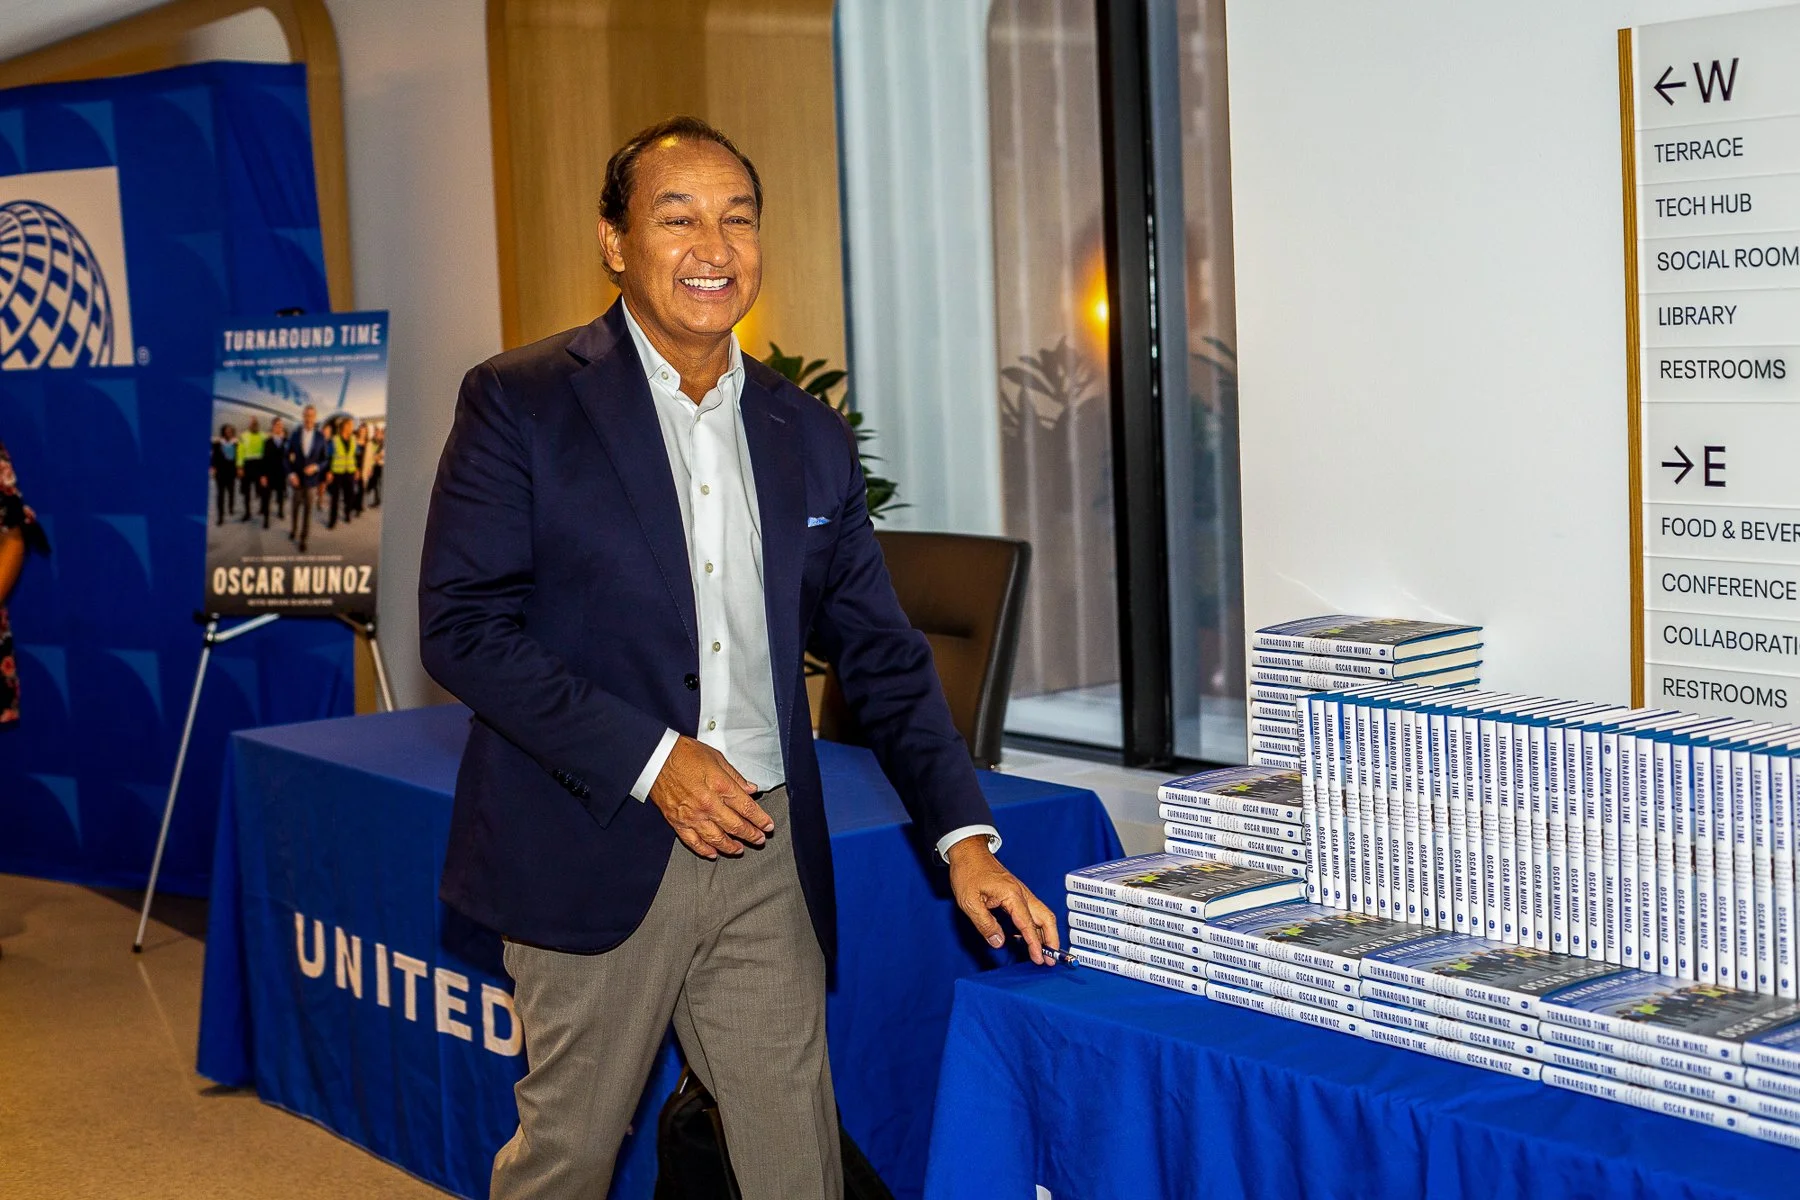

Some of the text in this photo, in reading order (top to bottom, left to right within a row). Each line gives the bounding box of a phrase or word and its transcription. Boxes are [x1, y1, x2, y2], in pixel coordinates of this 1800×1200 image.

[1693, 58, 1739, 103] W
[1654, 137, 1744, 163] TERRACE
[1656, 193, 1752, 217] TECH HUB
[1657, 250, 1730, 270] SOCIAL
[1658, 305, 1737, 326] LIBRARY
[224, 324, 381, 351] TURNAROUND TIME
[1660, 359, 1786, 379] RESTROOMS
[1704, 446, 1726, 487] E
[1662, 517, 1716, 538] FOOD
[1722, 520, 1736, 539] &
[213, 565, 372, 595] OSCAR MUNOZ
[1662, 573, 1797, 600] CONFERENCE
[1260, 637, 1291, 647] TURNAROUND
[1292, 640, 1304, 648] TIME
[1336, 645, 1352, 653] OSCAR
[1353, 646, 1371, 655] MUNOZ
[1663, 625, 1800, 656] COLLABORATI
[1259, 656, 1290, 665] TURNAROUND
[1291, 659, 1303, 667] TIME
[1335, 663, 1351, 672] OSCAR
[1353, 665, 1370, 674] MUNOZ
[1663, 678, 1788, 708] RESTROOMS
[1372, 720, 1380, 768] TURNAROUND
[1403, 723, 1411, 772] TURNAROUND
[1431, 728, 1440, 777] TURNAROUND
[1431, 728, 1440, 777] TURNAROUND
[1449, 729, 1458, 779] TURNAROUND
[1464, 731, 1473, 781] TURNAROUND
[1483, 733, 1491, 783] TURNAROUND
[1515, 738, 1523, 789] TURNAROUND
[1549, 742, 1557, 793] TURNAROUND
[1451, 782, 1459, 798] TIME
[1585, 746, 1594, 818] TURNAROUND TIME
[1639, 753, 1647, 806] TURNAROUND
[1165, 791, 1197, 803] TURNAROUND
[1198, 796, 1210, 805] TIME
[1484, 787, 1492, 804] TIME
[1696, 762, 1705, 836] TURNAROUND TIME
[1167, 809, 1198, 821] TURNAROUND
[1200, 815, 1211, 824] TIME
[1242, 804, 1258, 813] OSCAR
[1260, 806, 1278, 816] MUNOZ
[1604, 797, 1612, 823] OSCAR
[1172, 826, 1202, 839] TURNAROUND
[1204, 832, 1216, 842] TIME
[1244, 822, 1260, 832] OSCAR
[1261, 825, 1279, 835] MUNOZ
[1172, 845, 1216, 860] TURNAROUND TIME
[1247, 840, 1264, 850] OSCAR
[1265, 844, 1283, 854] MUNOZ
[1391, 839, 1399, 862] OSCAR
[1247, 859, 1264, 869] OSCAR
[1266, 863, 1284, 873] MUNOZ
[1436, 846, 1444, 870] OSCAR
[1436, 846, 1444, 870] OSCAR
[1453, 849, 1461, 873] OSCAR
[1468, 851, 1476, 876] OSCAR
[1392, 865, 1400, 890] MUNOZ
[1437, 873, 1445, 898] MUNOZ
[1552, 866, 1560, 890] OSCAR
[1588, 872, 1596, 897] OSCAR
[1072, 880, 1103, 894] TURNAROUND
[1105, 887, 1116, 897] TIME
[1641, 881, 1649, 907] OSCAR
[1074, 900, 1117, 917] TURNAROUND TIME
[1147, 896, 1163, 907] OSCAR
[1164, 900, 1182, 911] MUNOZ
[1699, 892, 1707, 918] OSCAR
[1076, 918, 1118, 935] TURNAROUND TIME
[1148, 917, 1165, 927] OSCAR
[1166, 921, 1184, 932] MUNOZ
[1149, 936, 1184, 951] OSCAR MUNOZ
[1209, 932, 1258, 951] TURNAROUND TIME
[1212, 950, 1260, 970] TURNAROUND TIME
[1293, 952, 1311, 963] OSCAR
[1313, 957, 1333, 968] MUNOZ
[295, 912, 524, 1056] UNITED
[1295, 971, 1313, 983] OSCAR
[1315, 976, 1334, 989] MUNOZ
[1370, 965, 1425, 986] TURNAROUND TIME
[1215, 990, 1264, 1009] TURNAROUND TIME
[1371, 987, 1426, 1008] TURNAROUND TIME
[1465, 988, 1510, 1006] OSCAR MUNOZ
[1299, 1011, 1339, 1028] OSCAR MUNOZ
[1372, 1009, 1428, 1030] TURNAROUND TIME
[1466, 1010, 1510, 1028] OSCAR MUNOZ
[1547, 1010, 1591, 1027] TURNAROUND
[1469, 1032, 1514, 1050] OSCAR MUNOZ
